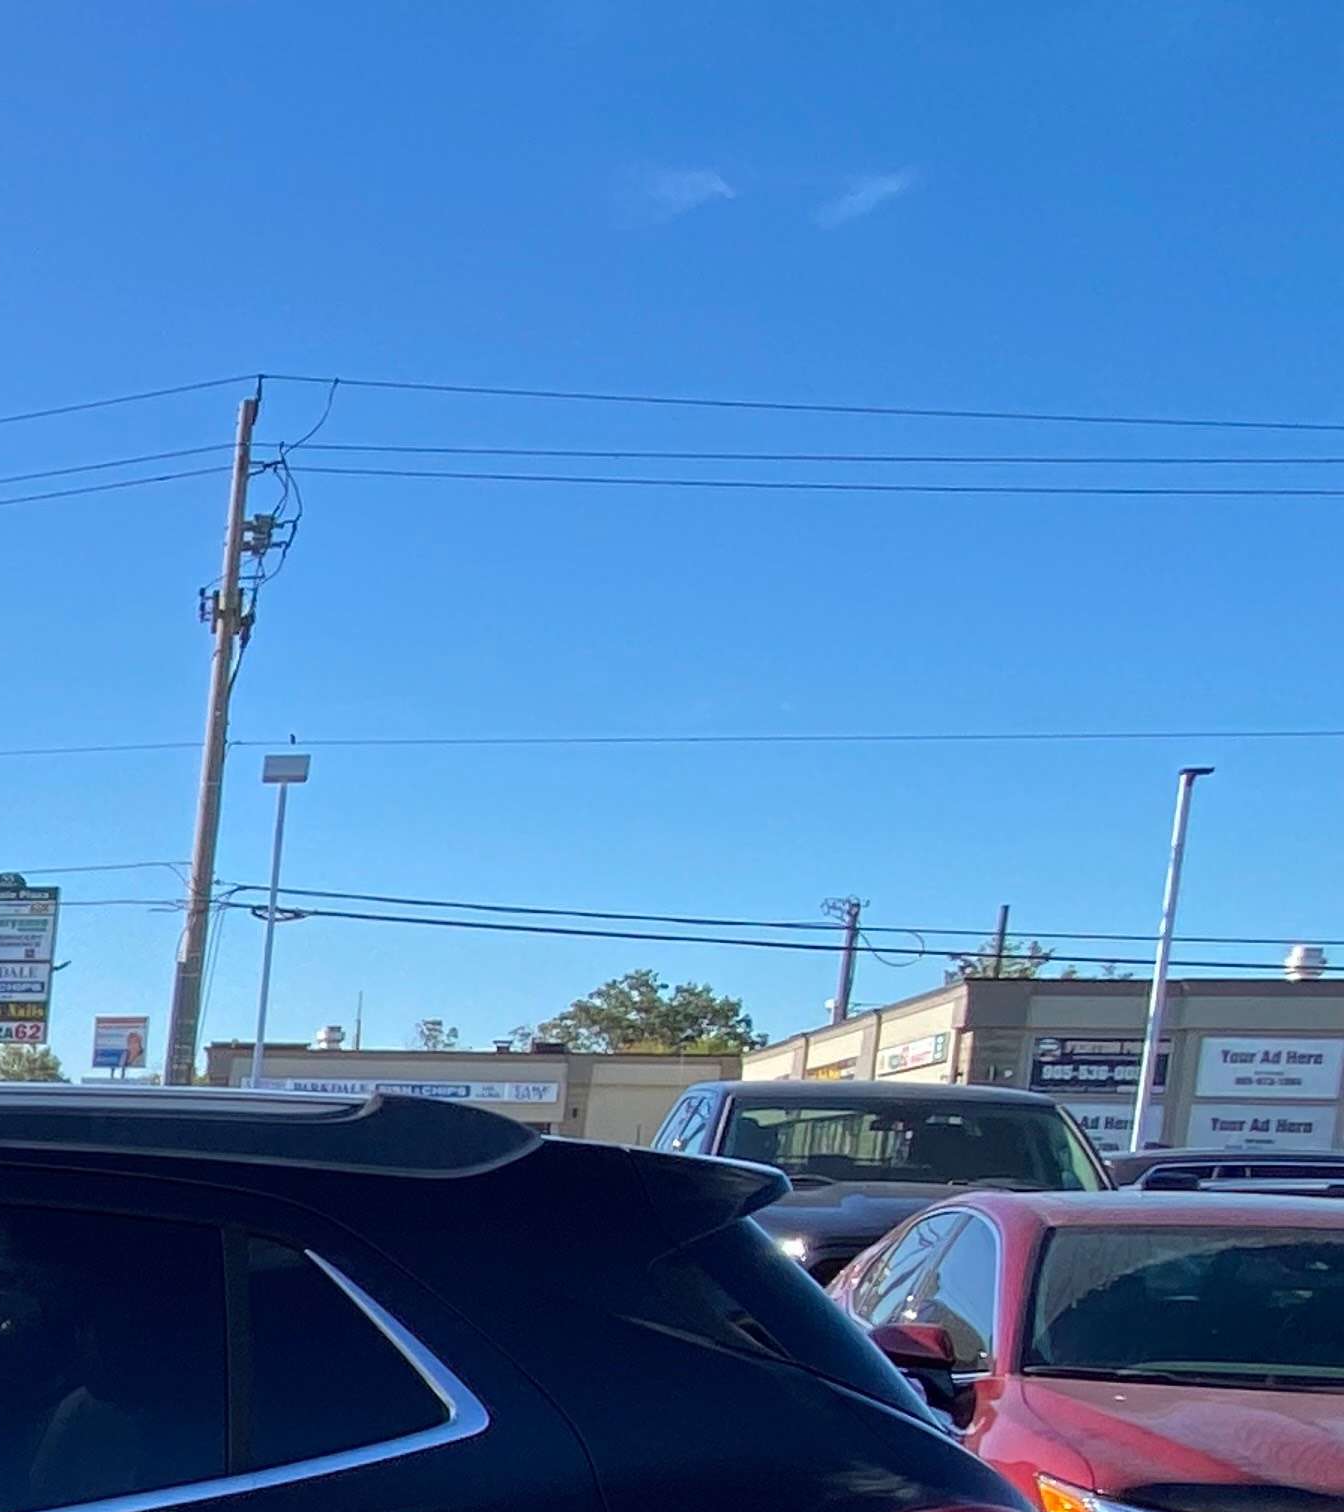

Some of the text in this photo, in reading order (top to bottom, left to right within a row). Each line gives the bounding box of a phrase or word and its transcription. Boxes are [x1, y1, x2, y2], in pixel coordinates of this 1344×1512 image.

[14, 1023, 41, 1040] 62
[1221, 1049, 1324, 1065] Your Ad Here
[1249, 1118, 1270, 1132] Ad
